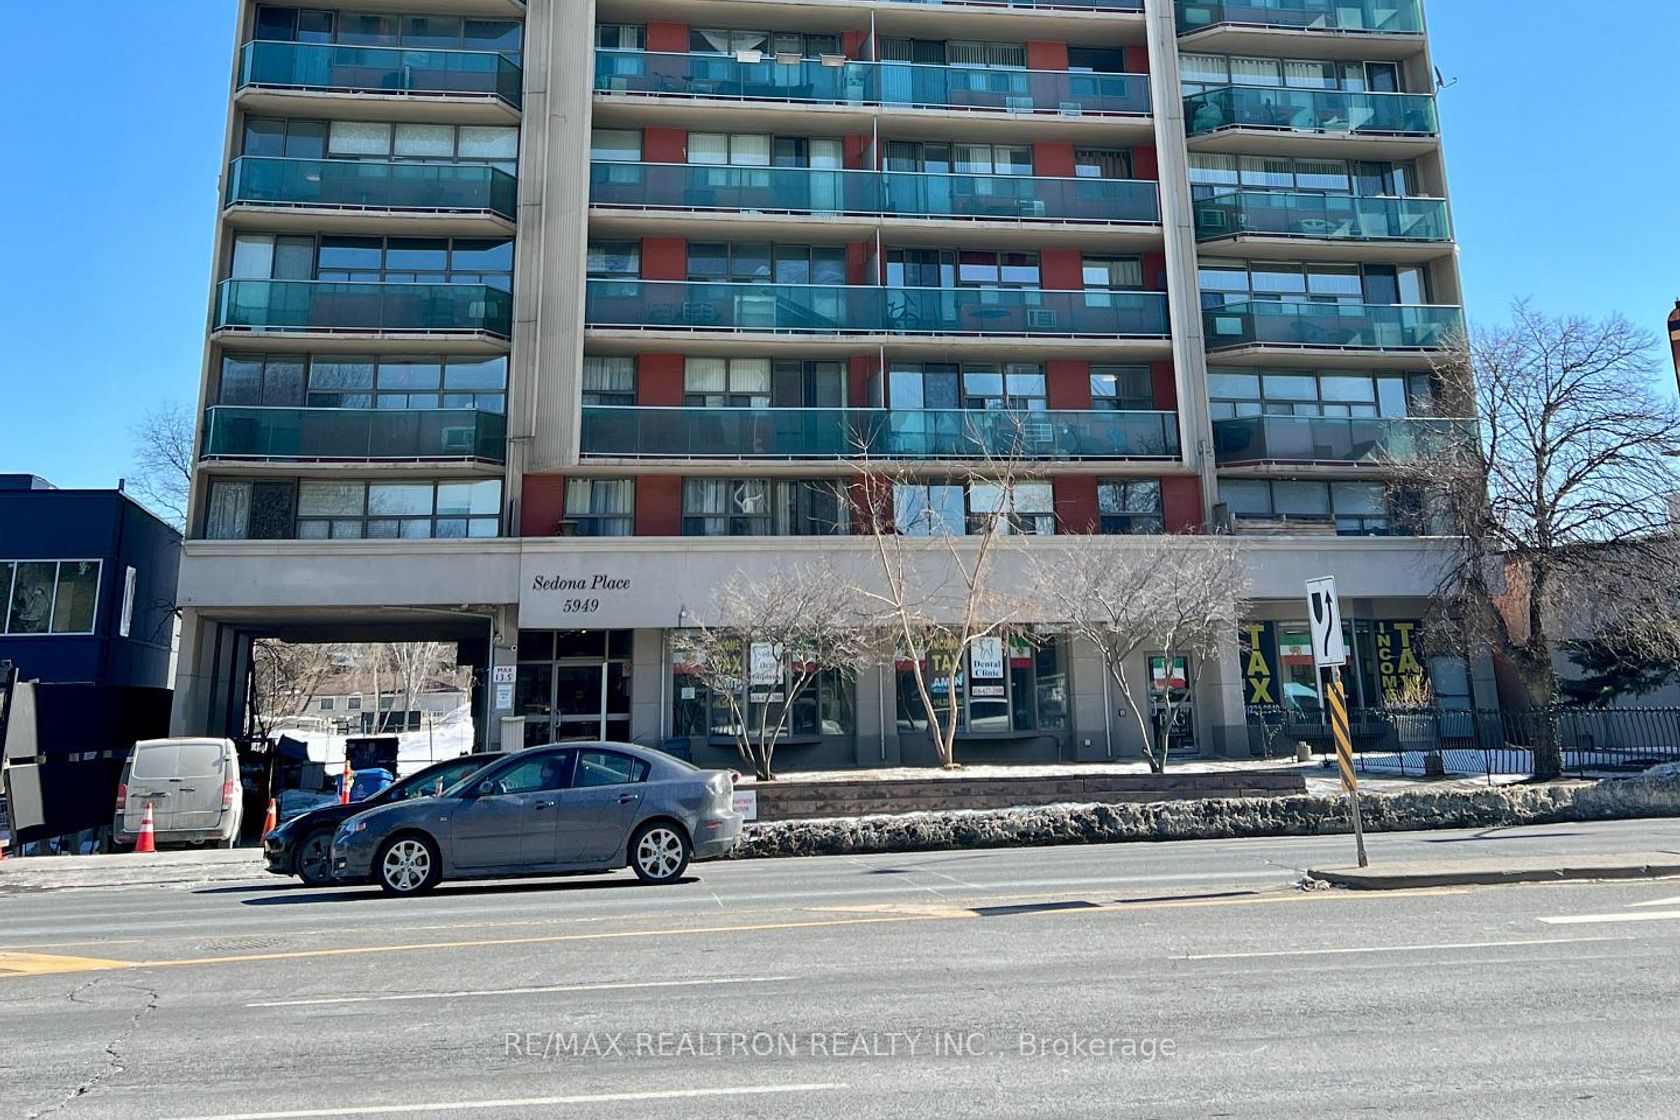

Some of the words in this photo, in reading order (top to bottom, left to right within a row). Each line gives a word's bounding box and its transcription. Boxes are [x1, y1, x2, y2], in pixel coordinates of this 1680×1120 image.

[532, 575, 587, 591] Sedona
[591, 574, 631, 590] Place
[563, 598, 599, 613] 5949
[974, 660, 1001, 668] Dental
[1246, 624, 1274, 704] TAX
[975, 669, 1000, 677] Clinic
[932, 676, 963, 687] AMN
